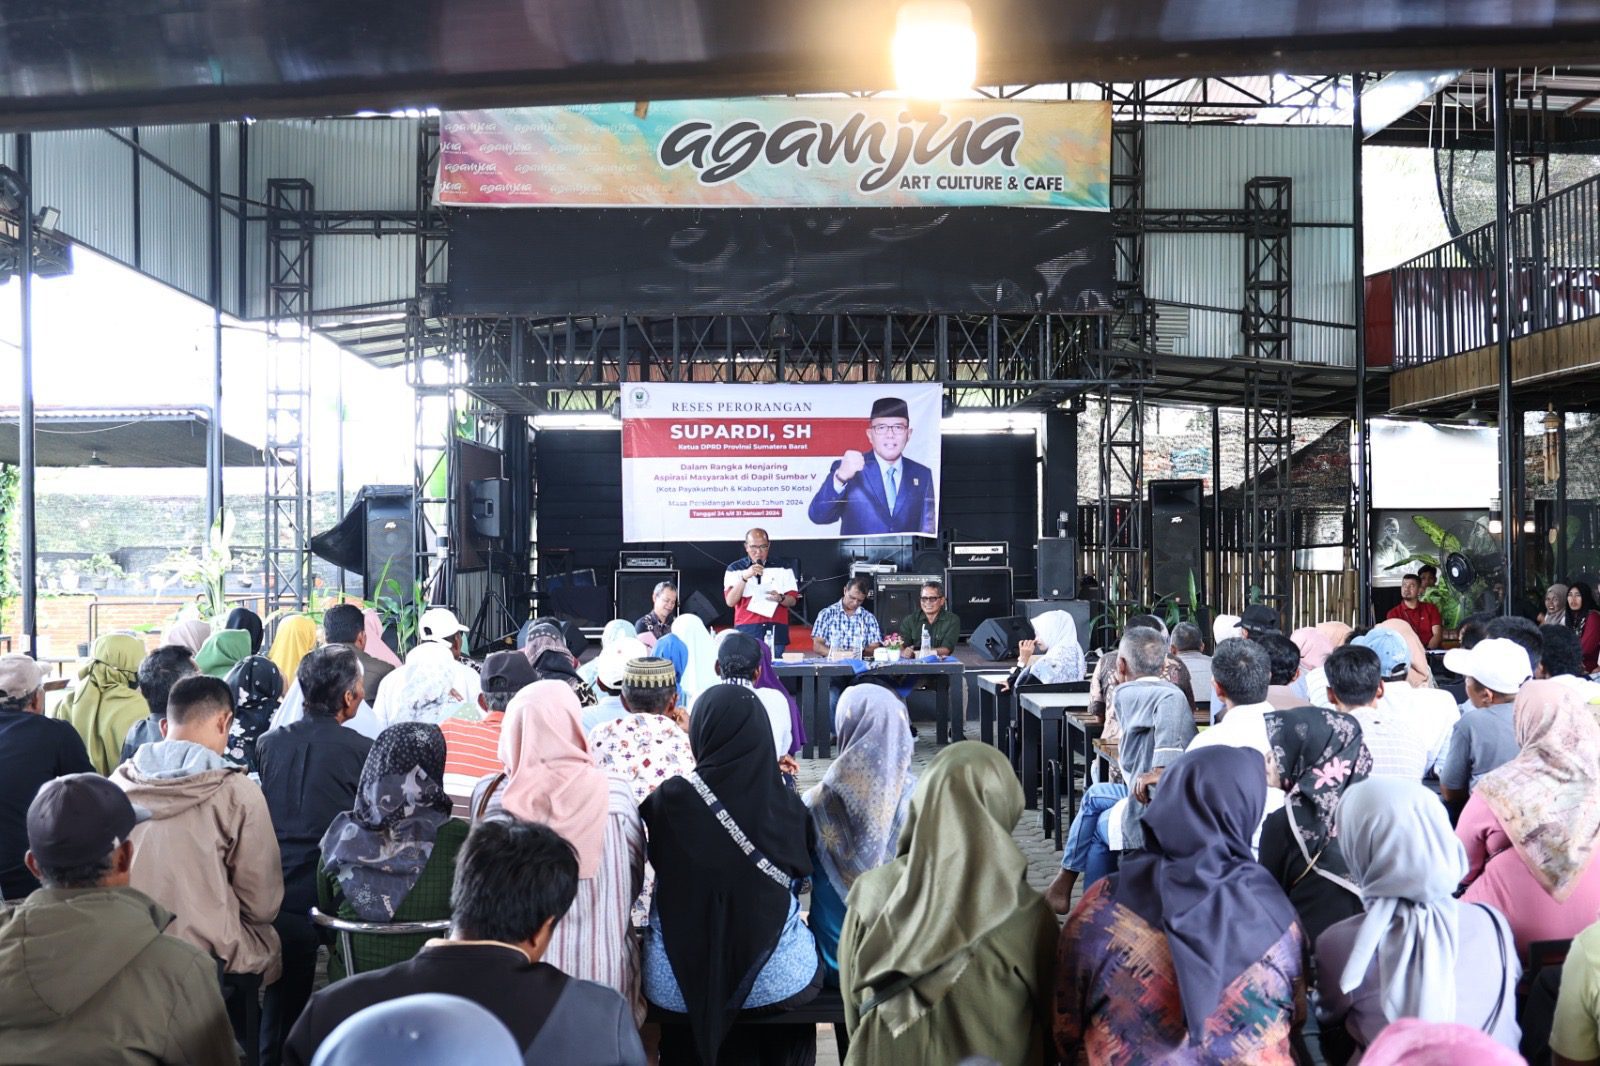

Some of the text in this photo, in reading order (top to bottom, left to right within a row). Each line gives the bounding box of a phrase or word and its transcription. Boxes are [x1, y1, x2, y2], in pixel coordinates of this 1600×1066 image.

[661, 112, 1021, 192] agamjua
[899, 175, 1063, 191] ART CULTURE & CAFE
[672, 401, 812, 412] RESES PERORANGAN
[670, 424, 811, 441] SUPARDI, SH
[680, 463, 788, 472] Dalam Rangka Menjaring
[654, 473, 688, 482] Aspirasi
[689, 473, 738, 482] Masyarakat
[751, 473, 774, 481] Dapil
[656, 486, 677, 494] (Kota
[678, 486, 729, 494] Payakumbuh
[737, 485, 779, 493] Kabupaten
[716, 808, 756, 856] SUPREME
